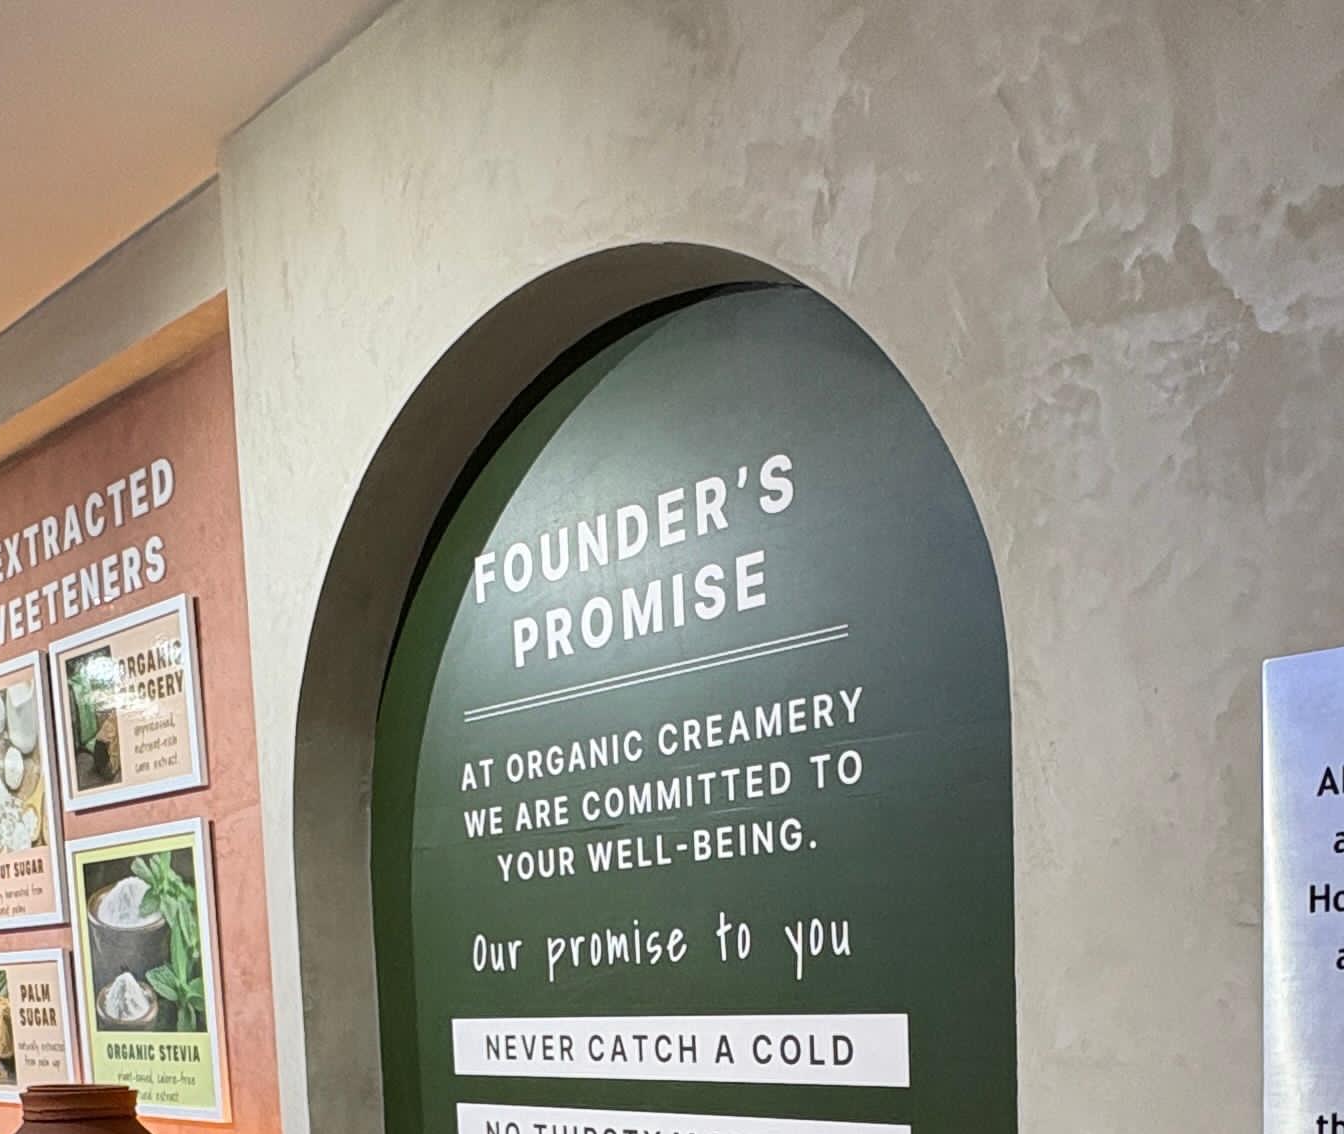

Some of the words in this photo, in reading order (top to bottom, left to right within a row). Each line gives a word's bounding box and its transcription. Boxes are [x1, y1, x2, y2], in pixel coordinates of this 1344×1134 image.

[473, 454, 795, 604] FOUNDER'S
[513, 550, 767, 668] PROMISE
[461, 759, 494, 791] AT
[506, 730, 643, 782] ORGANIC
[658, 686, 864, 756] CREAMERY
[464, 806, 504, 838] WE
[515, 796, 569, 831] ARE
[582, 761, 792, 821] COMMITTED
[809, 750, 863, 789] TO
[14, 859, 44, 876] SUGAR
[497, 846, 575, 882] YOUR
[587, 817, 817, 872] WELL-BEING.
[473, 933, 523, 972] Our
[547, 919, 688, 982] promise
[716, 911, 751, 961] to
[785, 917, 852, 980] you
[20, 984, 51, 1003] PALM
[20, 1008, 57, 1027] SUGAR
[106, 1044, 155, 1061] ORGANIC
[159, 1045, 201, 1062] STEVIA
[485, 1034, 575, 1062] NEVER
[588, 1034, 698, 1064] CATCH
[715, 1035, 735, 1064] A
[752, 1034, 856, 1067] COLD
